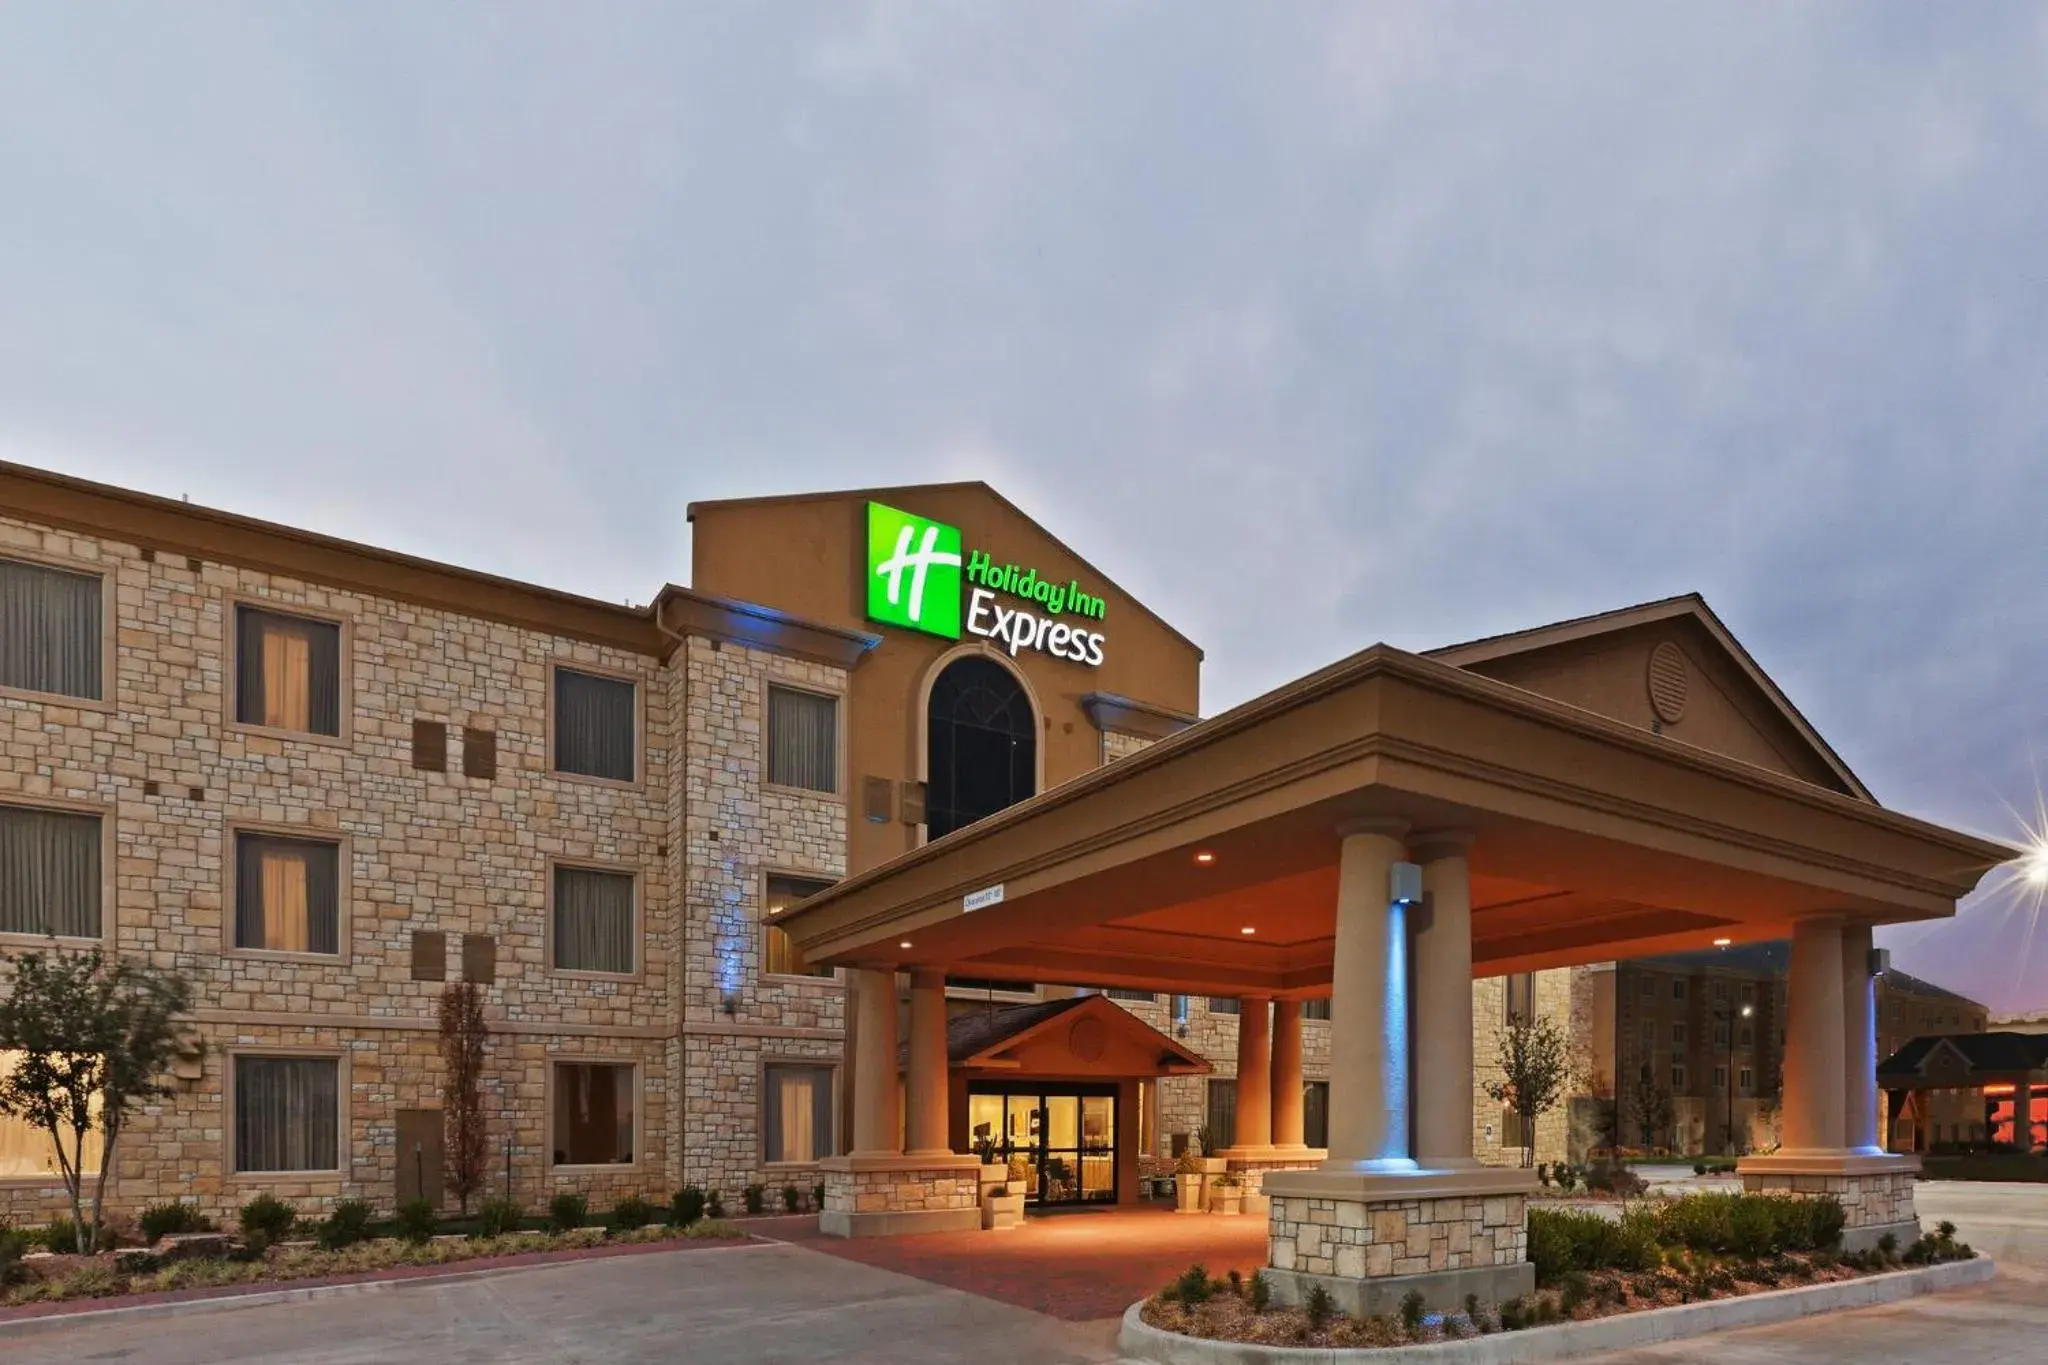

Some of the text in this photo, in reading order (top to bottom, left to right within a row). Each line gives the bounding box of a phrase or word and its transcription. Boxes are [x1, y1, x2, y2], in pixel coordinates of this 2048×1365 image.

[967, 550, 1105, 619] Holiday Inn
[966, 588, 1105, 666] Express
